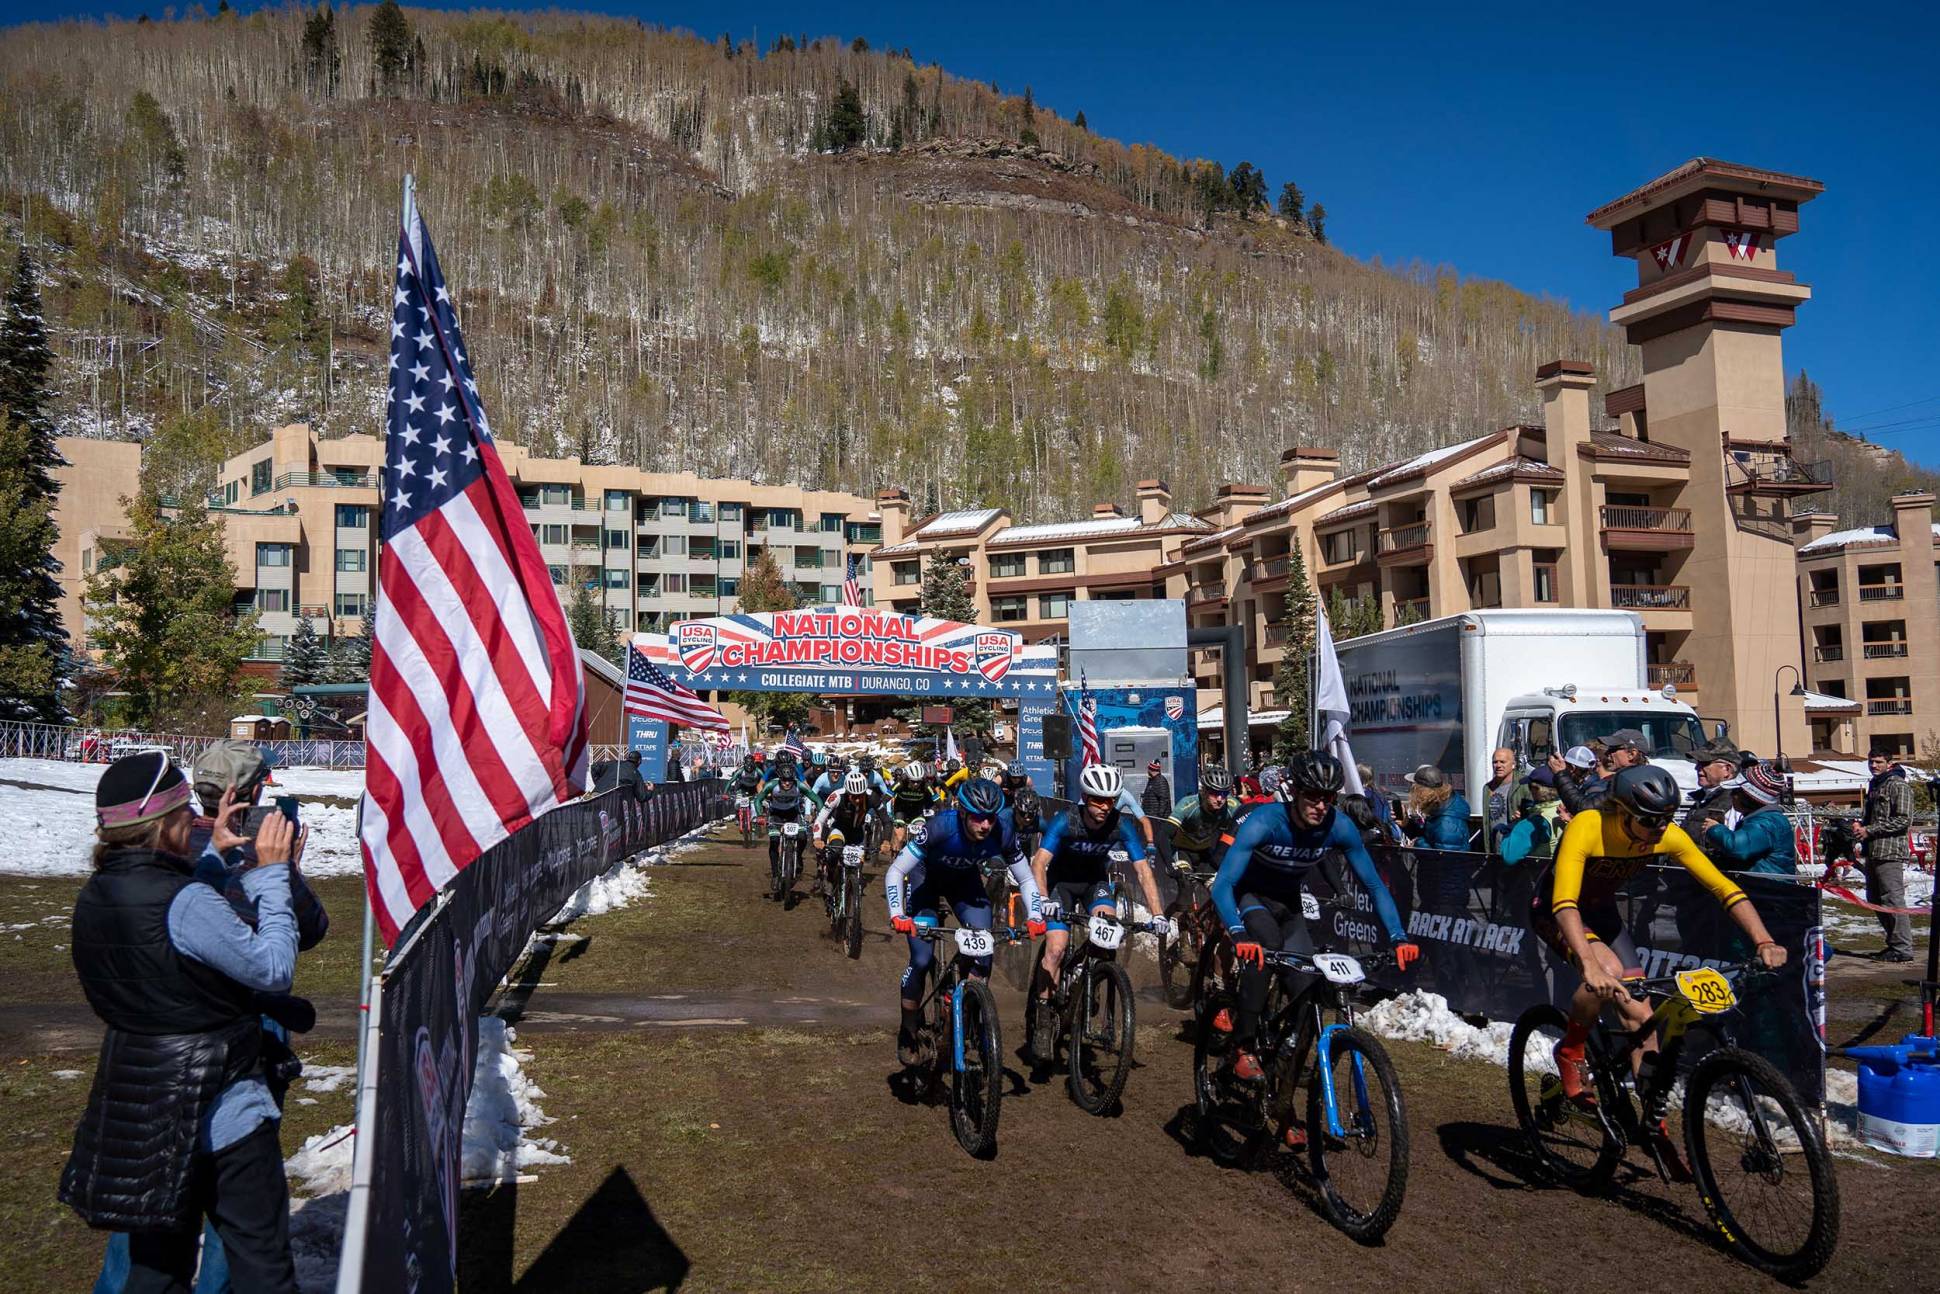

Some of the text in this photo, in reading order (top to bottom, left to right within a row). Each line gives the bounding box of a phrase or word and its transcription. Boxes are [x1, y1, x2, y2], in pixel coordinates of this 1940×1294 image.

[682, 627, 713, 638] USA
[774, 613, 920, 641] NATIONAL
[979, 635, 1009, 646] USA
[721, 640, 970, 674] CHAMPIONSHIPS
[761, 673, 852, 689] COLLEGIATE MTB
[862, 677, 930, 692] DURANGO, CO
[1349, 669, 1400, 696] NATIONAL
[1022, 706, 1055, 715] Athletic
[1350, 693, 1443, 723] CHAMPIONSHIPS
[1023, 715, 1043, 723] Gree
[636, 731, 657, 739] THRU
[1026, 741, 1044, 750] THR
[887, 885, 900, 908] KING
[1031, 892, 1041, 913] KING
[1095, 926, 1115, 942] 467
[1333, 911, 1377, 943] Greens
[1406, 910, 1525, 954] RACK ATTACK
[963, 938, 986, 950] 439
[1330, 961, 1351, 975] 411
[1692, 981, 1726, 1005] 283
